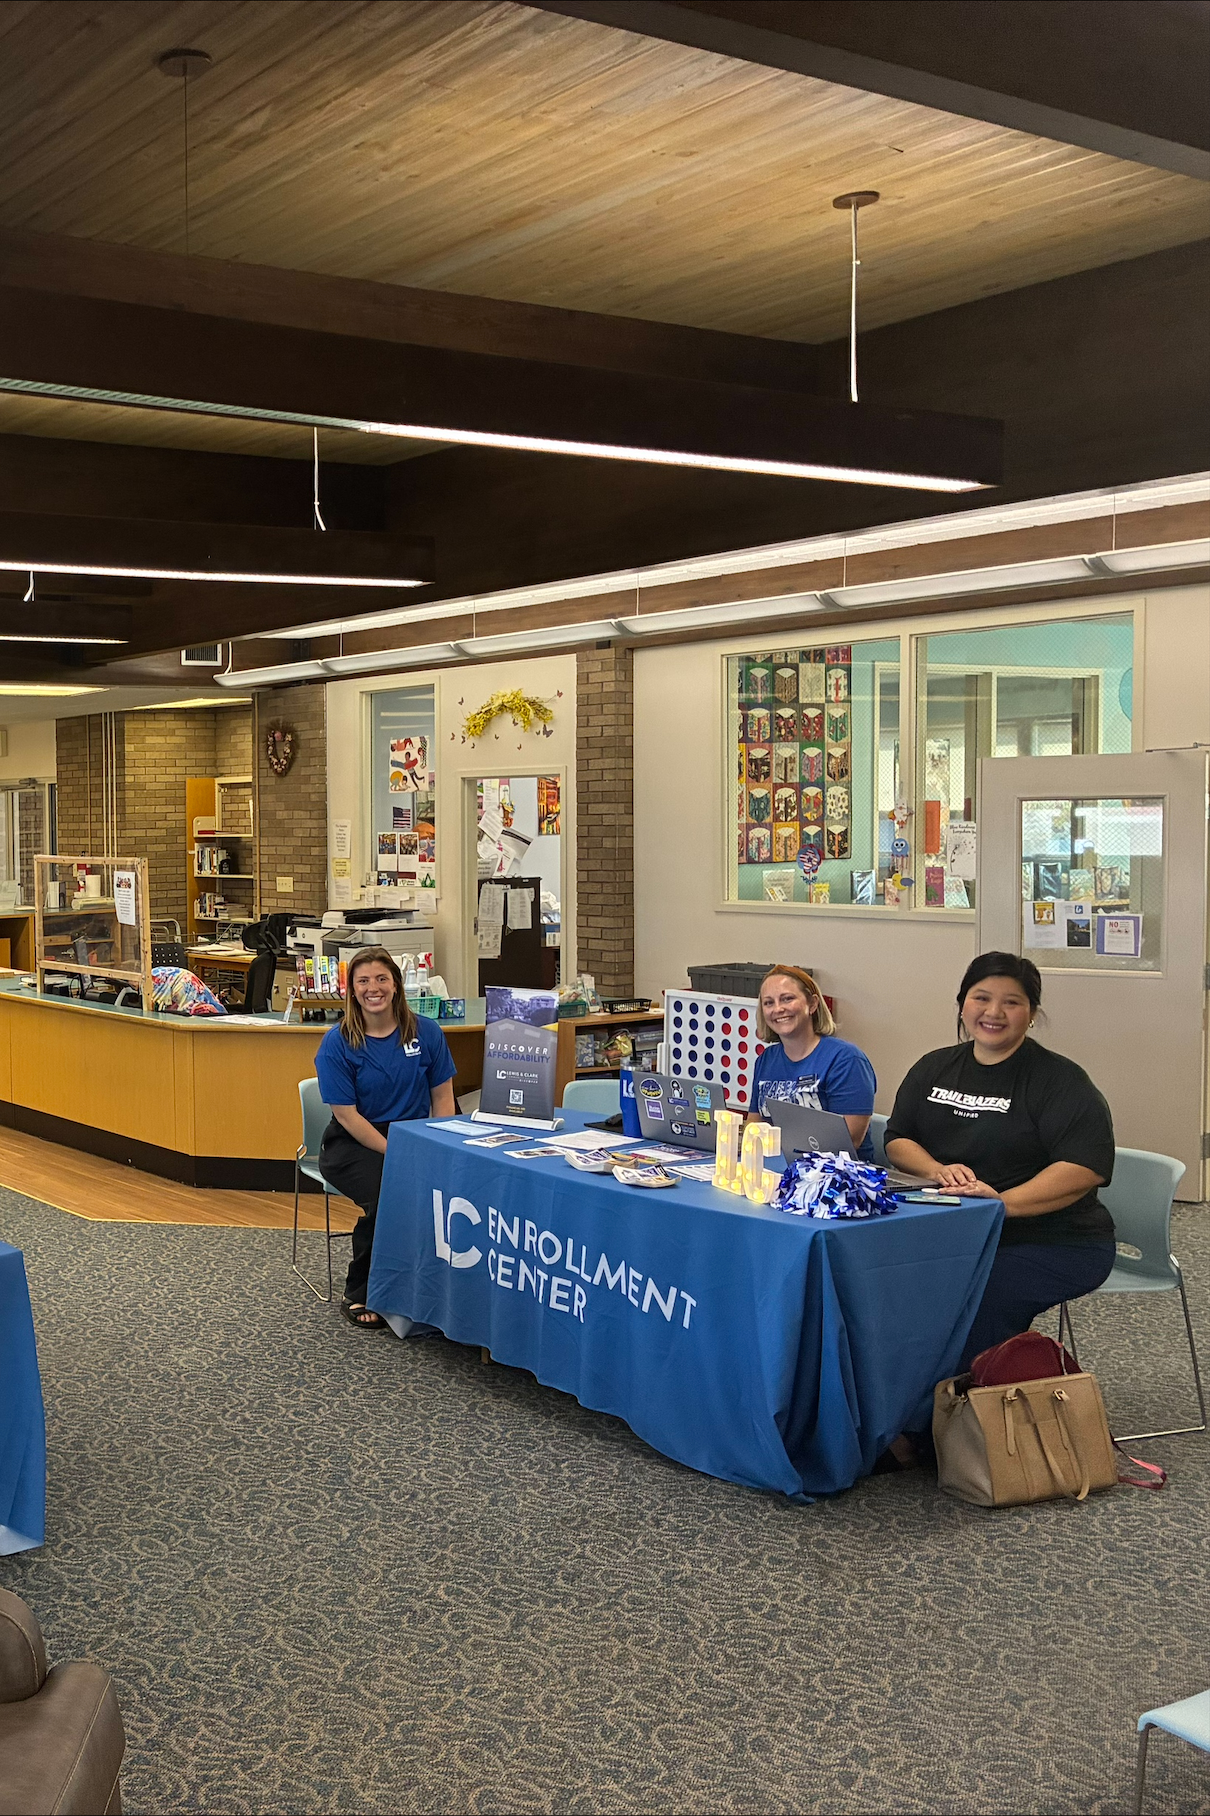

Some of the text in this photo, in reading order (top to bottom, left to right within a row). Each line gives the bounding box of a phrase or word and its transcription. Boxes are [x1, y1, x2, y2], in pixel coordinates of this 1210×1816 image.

[404, 1038, 420, 1054] LC
[489, 1042, 549, 1055] DISCOVER
[487, 1050, 551, 1064] AFFORDABILITY
[496, 1069, 507, 1080] LC
[930, 1086, 1012, 1110] TRAILBLAZERS
[953, 1109, 979, 1119] UNIFIED
[433, 1188, 697, 1330] LC ENROLLMENT
[487, 1247, 588, 1324] CENTER
